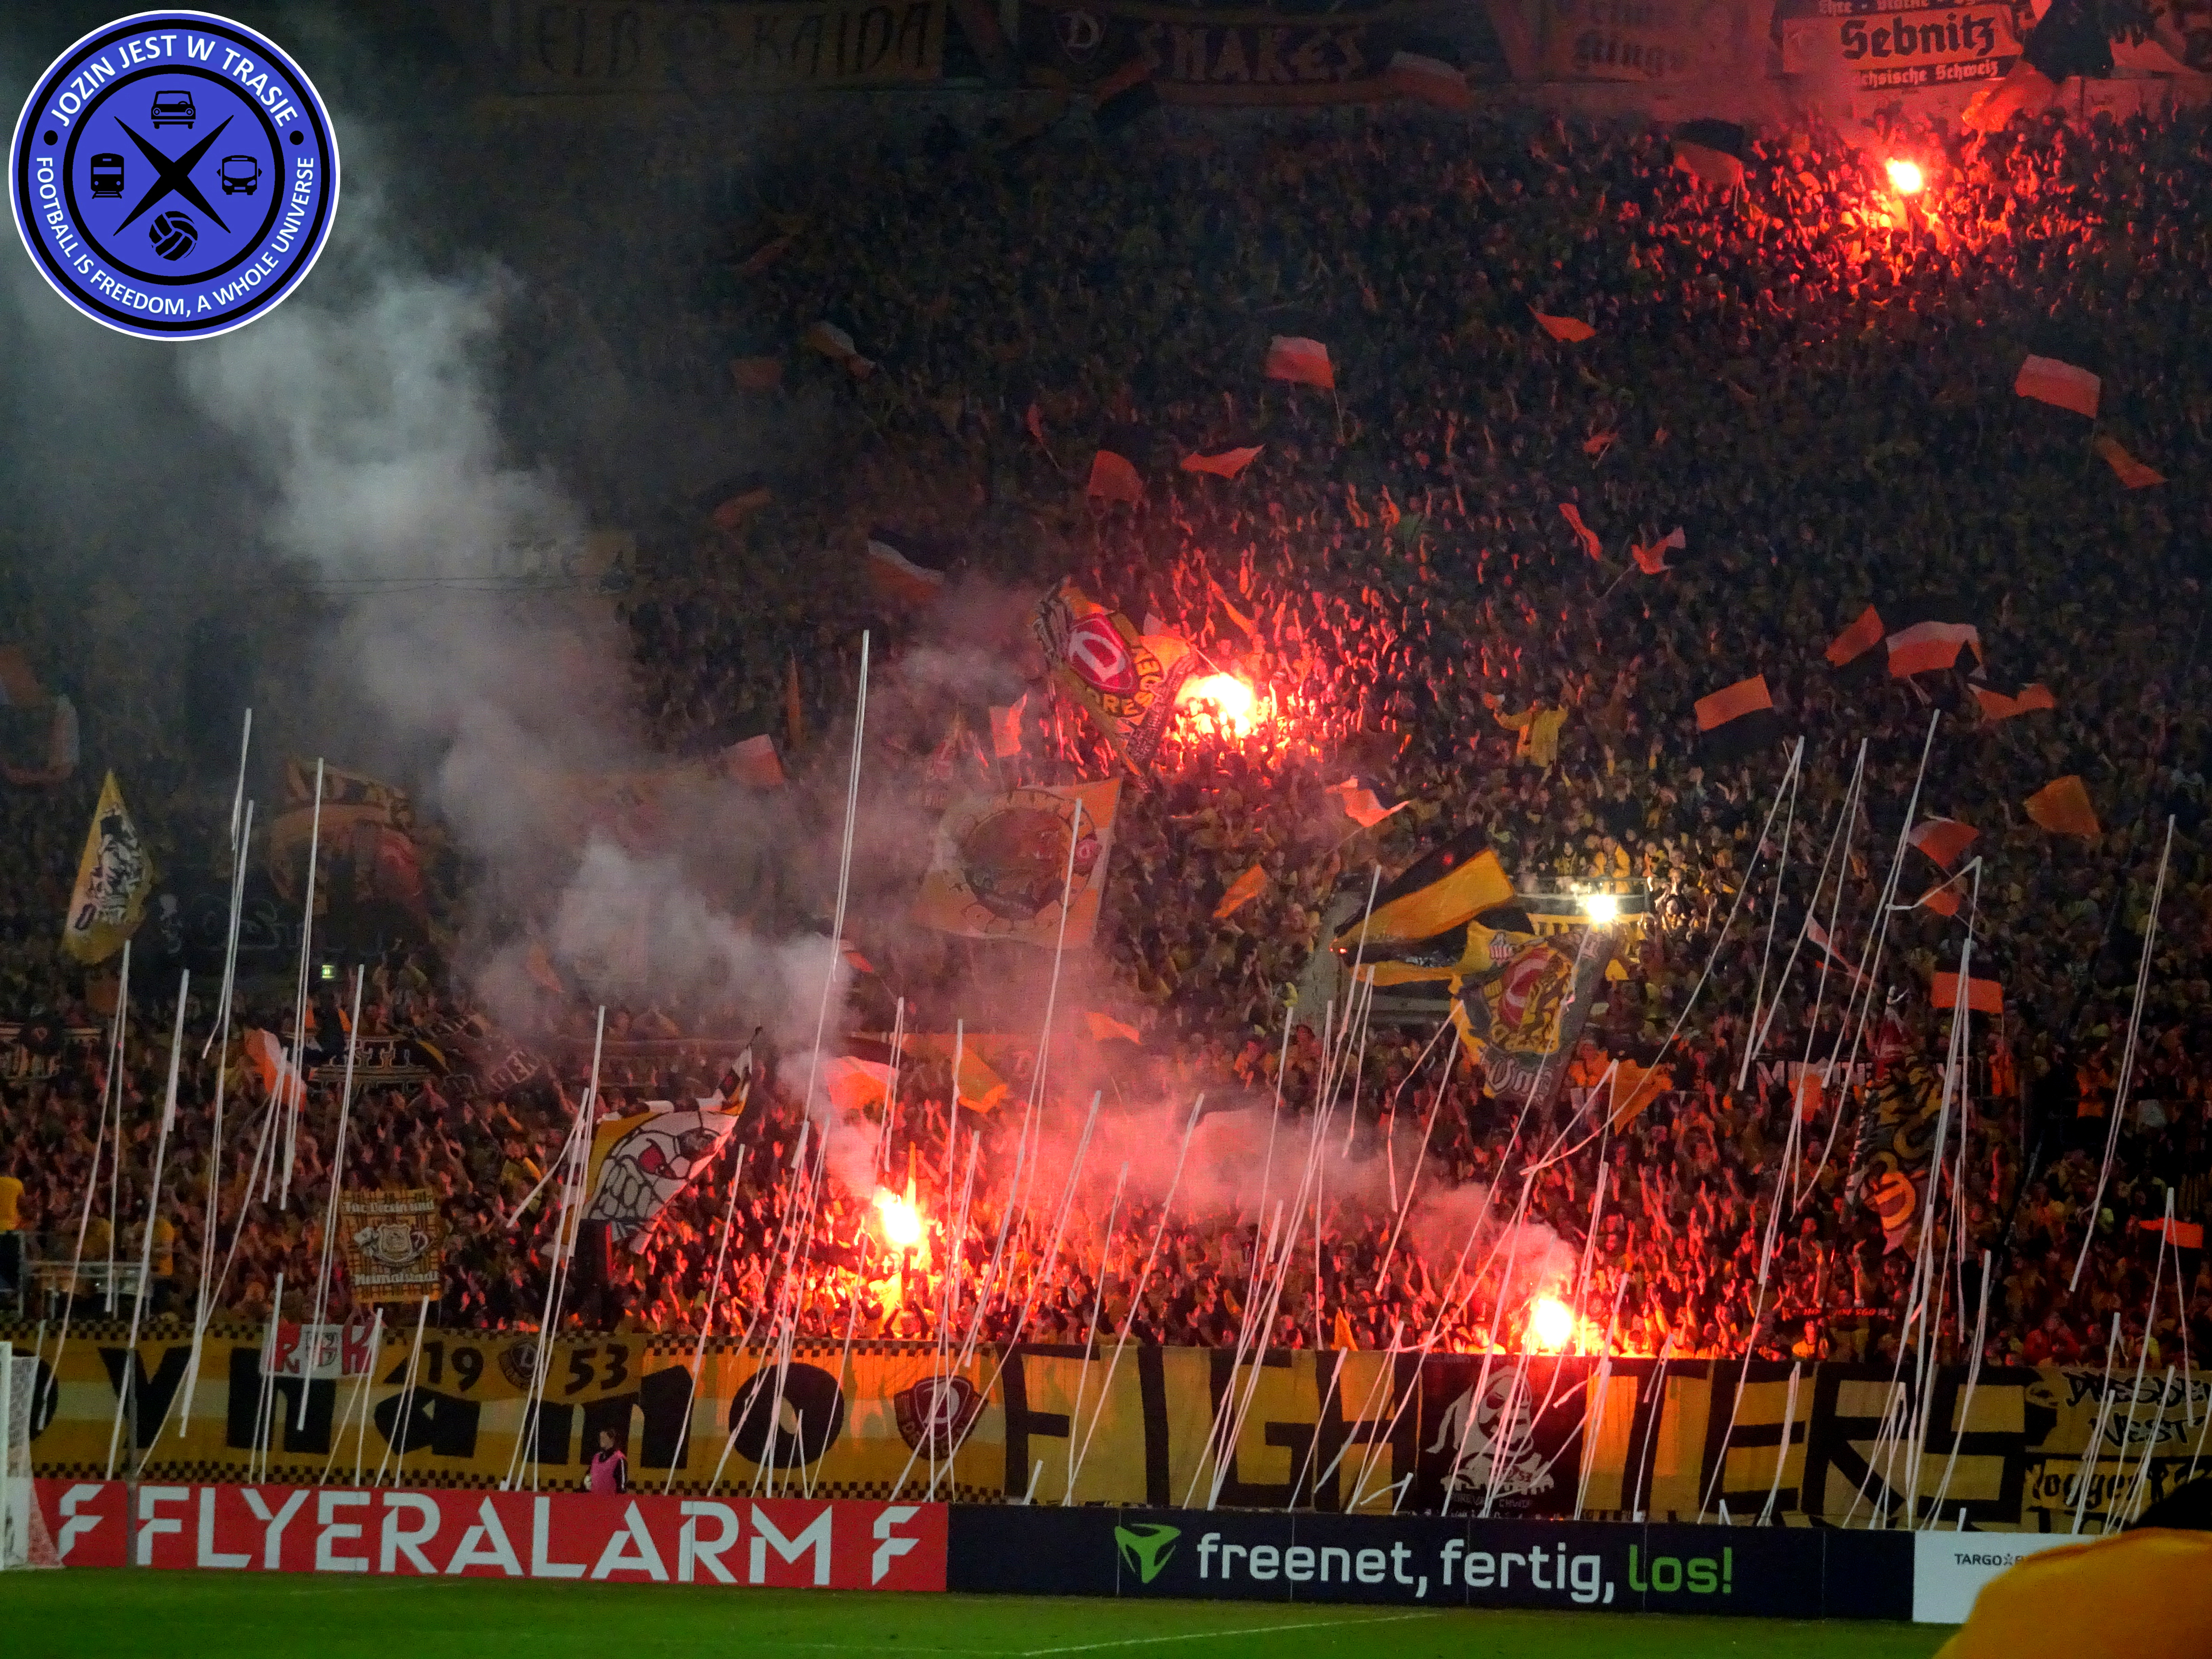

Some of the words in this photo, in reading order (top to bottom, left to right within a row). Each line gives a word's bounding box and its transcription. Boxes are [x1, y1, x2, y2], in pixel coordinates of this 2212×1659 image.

[1840, 12, 1995, 60] Sebnitz
[1859, 67, 1927, 88] chsische
[1935, 59, 1998, 81] Schweiz
[423, 1339, 484, 1392] 19
[565, 1343, 629, 1395] 53
[137, 1483, 834, 1586] FLYERALARM
[1196, 1532, 1429, 1598] freenet,
[1439, 1538, 1616, 1604] fertig,
[1628, 1544, 1733, 1594] los!
